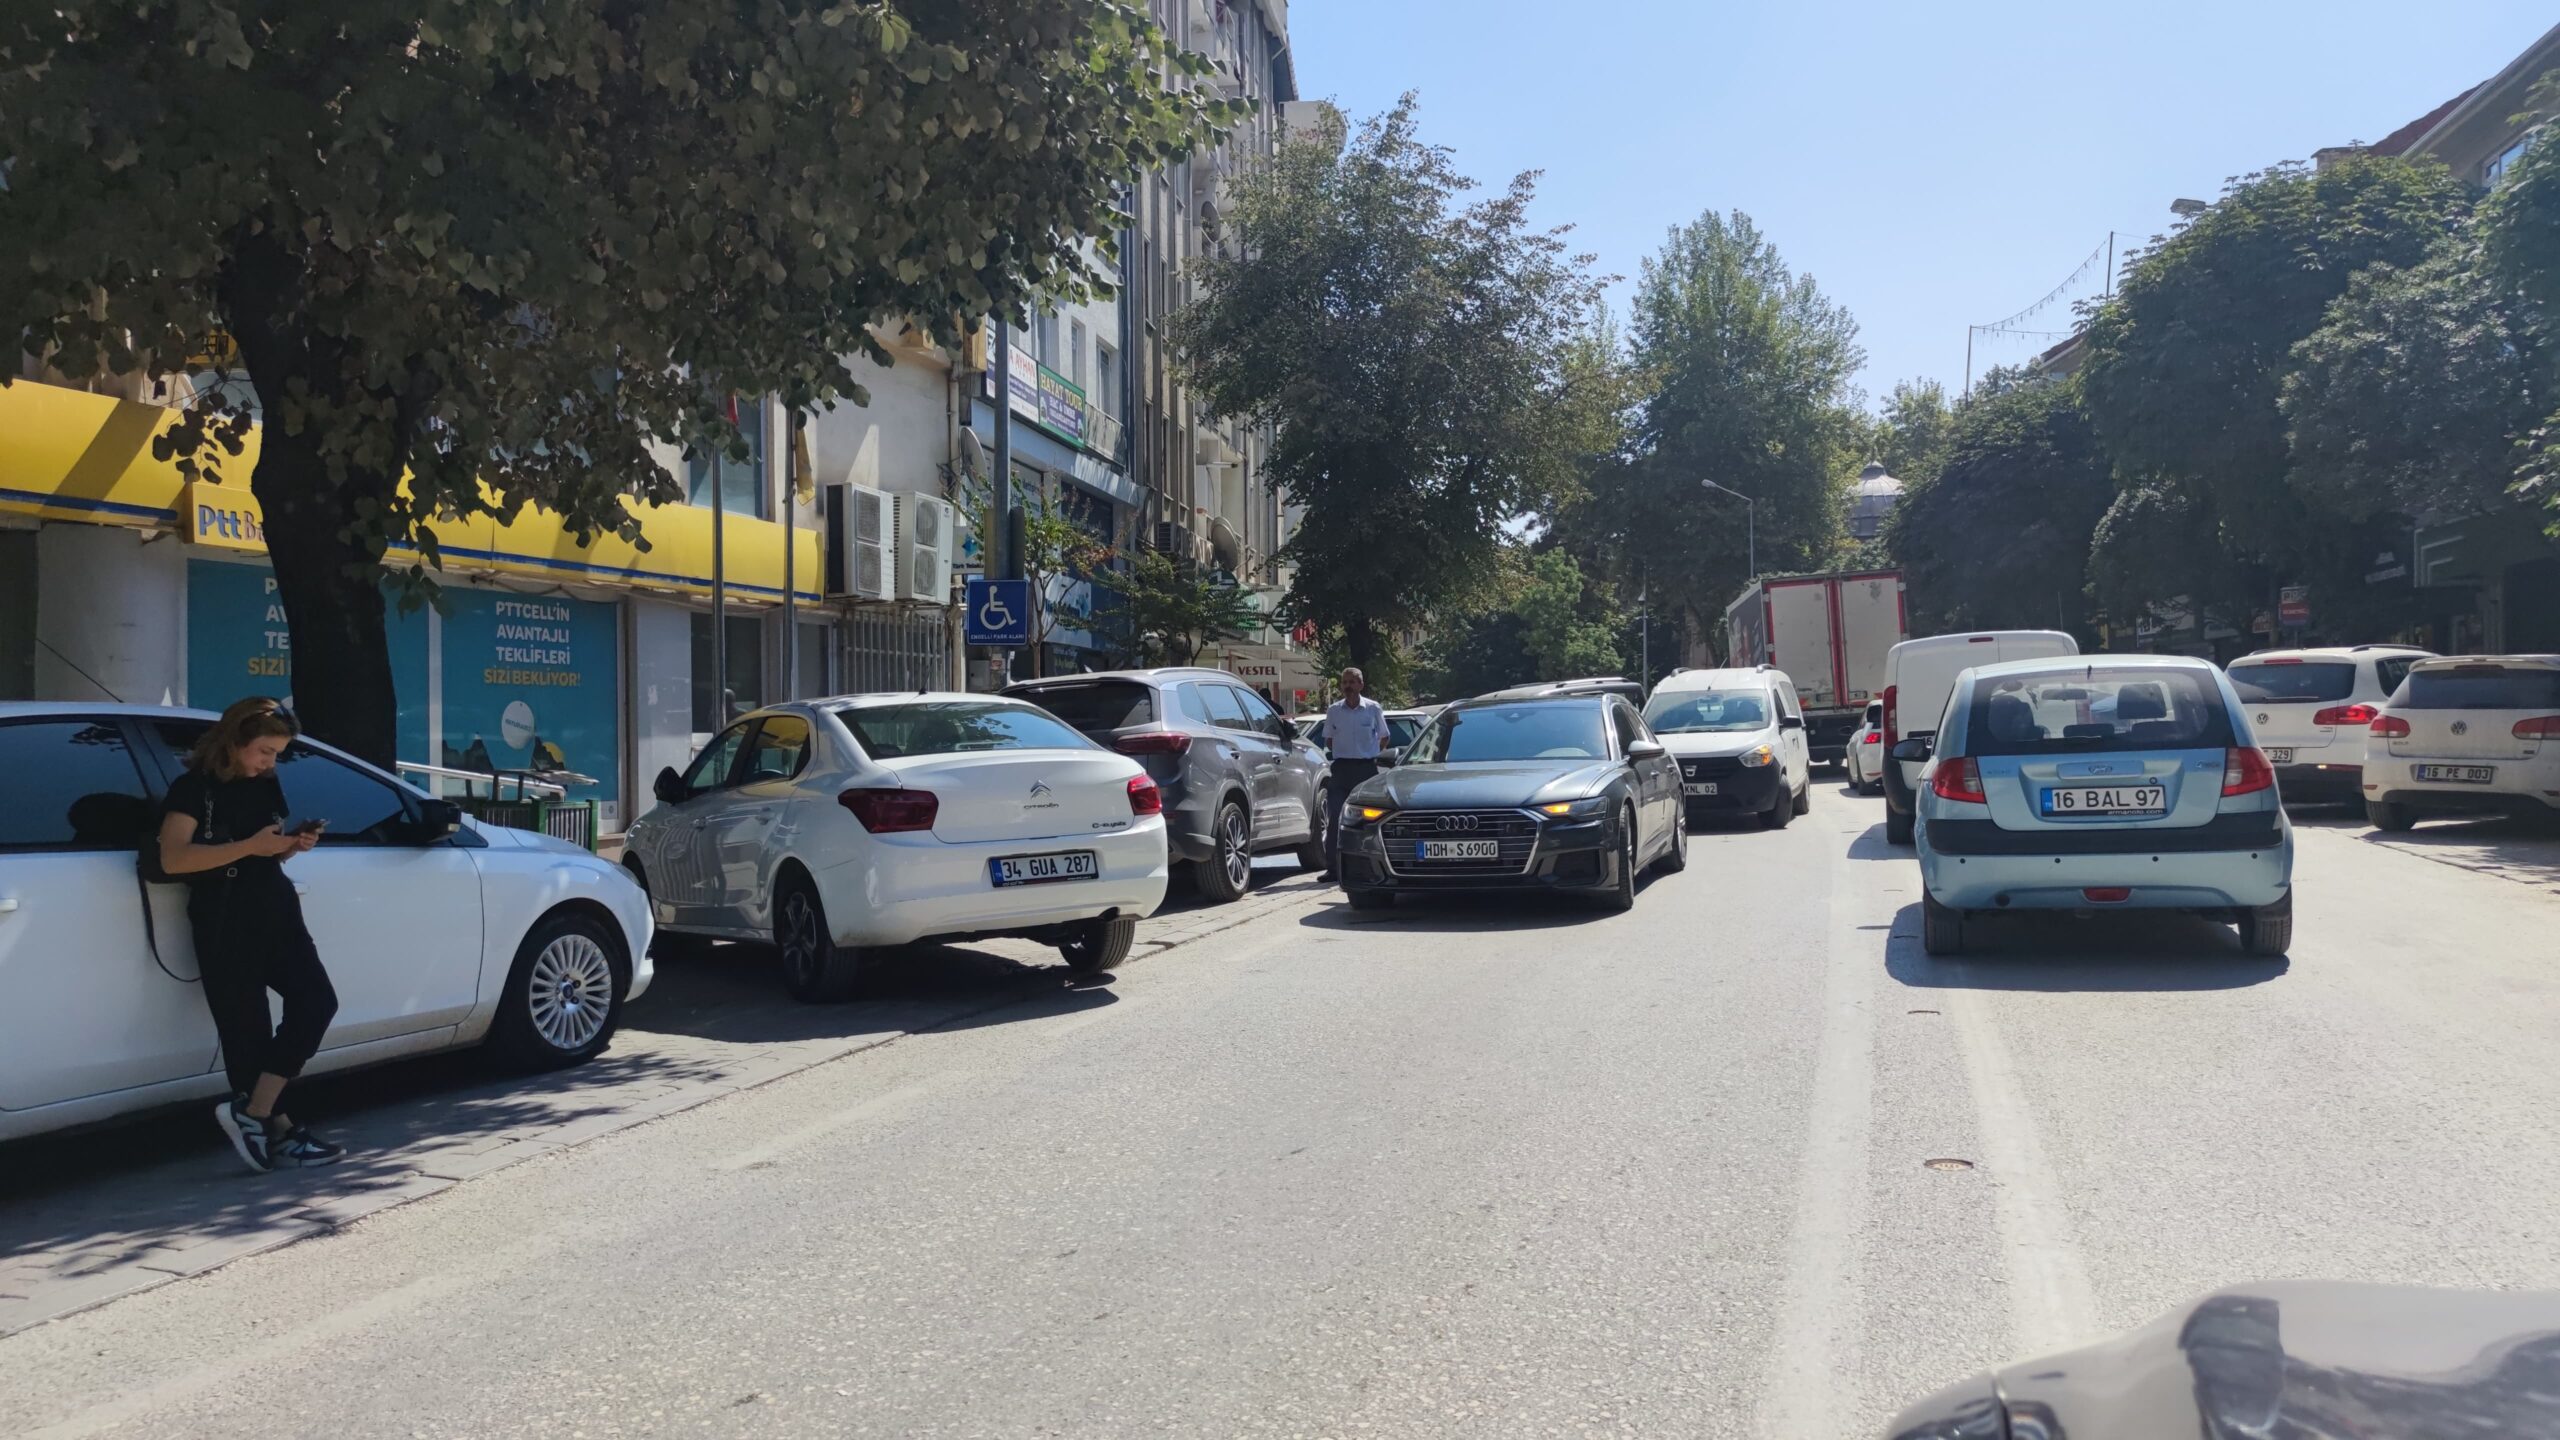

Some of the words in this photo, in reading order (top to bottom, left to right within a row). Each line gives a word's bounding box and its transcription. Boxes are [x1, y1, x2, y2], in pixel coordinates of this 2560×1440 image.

[1040, 373, 1063, 400] HAYAT
[1065, 391, 1084, 412] TOUR
[496, 624, 570, 643] AVANTAJLI
[248, 652, 285, 676] SİZİ
[496, 644, 571, 665] TEKLİFLERİ
[484, 665, 511, 684] SİZİ
[513, 667, 581, 687] BEKLİYOR!
[1238, 666, 1278, 676] VESTEL
[2272, 750, 2289, 759] 329
[2446, 767, 2461, 778] PE
[2467, 769, 2489, 780] 003
[1705, 785, 1716, 794] 02
[2054, 792, 2074, 809] 16
[2085, 790, 2131, 808] BAL
[2135, 789, 2161, 807] 97
[1425, 843, 1448, 856] HDH
[1457, 843, 1464, 856] S
[1466, 843, 1496, 856] 6900
[1002, 862, 1022, 879] 34
[1029, 858, 1058, 877] GUA
[1063, 855, 1090, 874] 287
